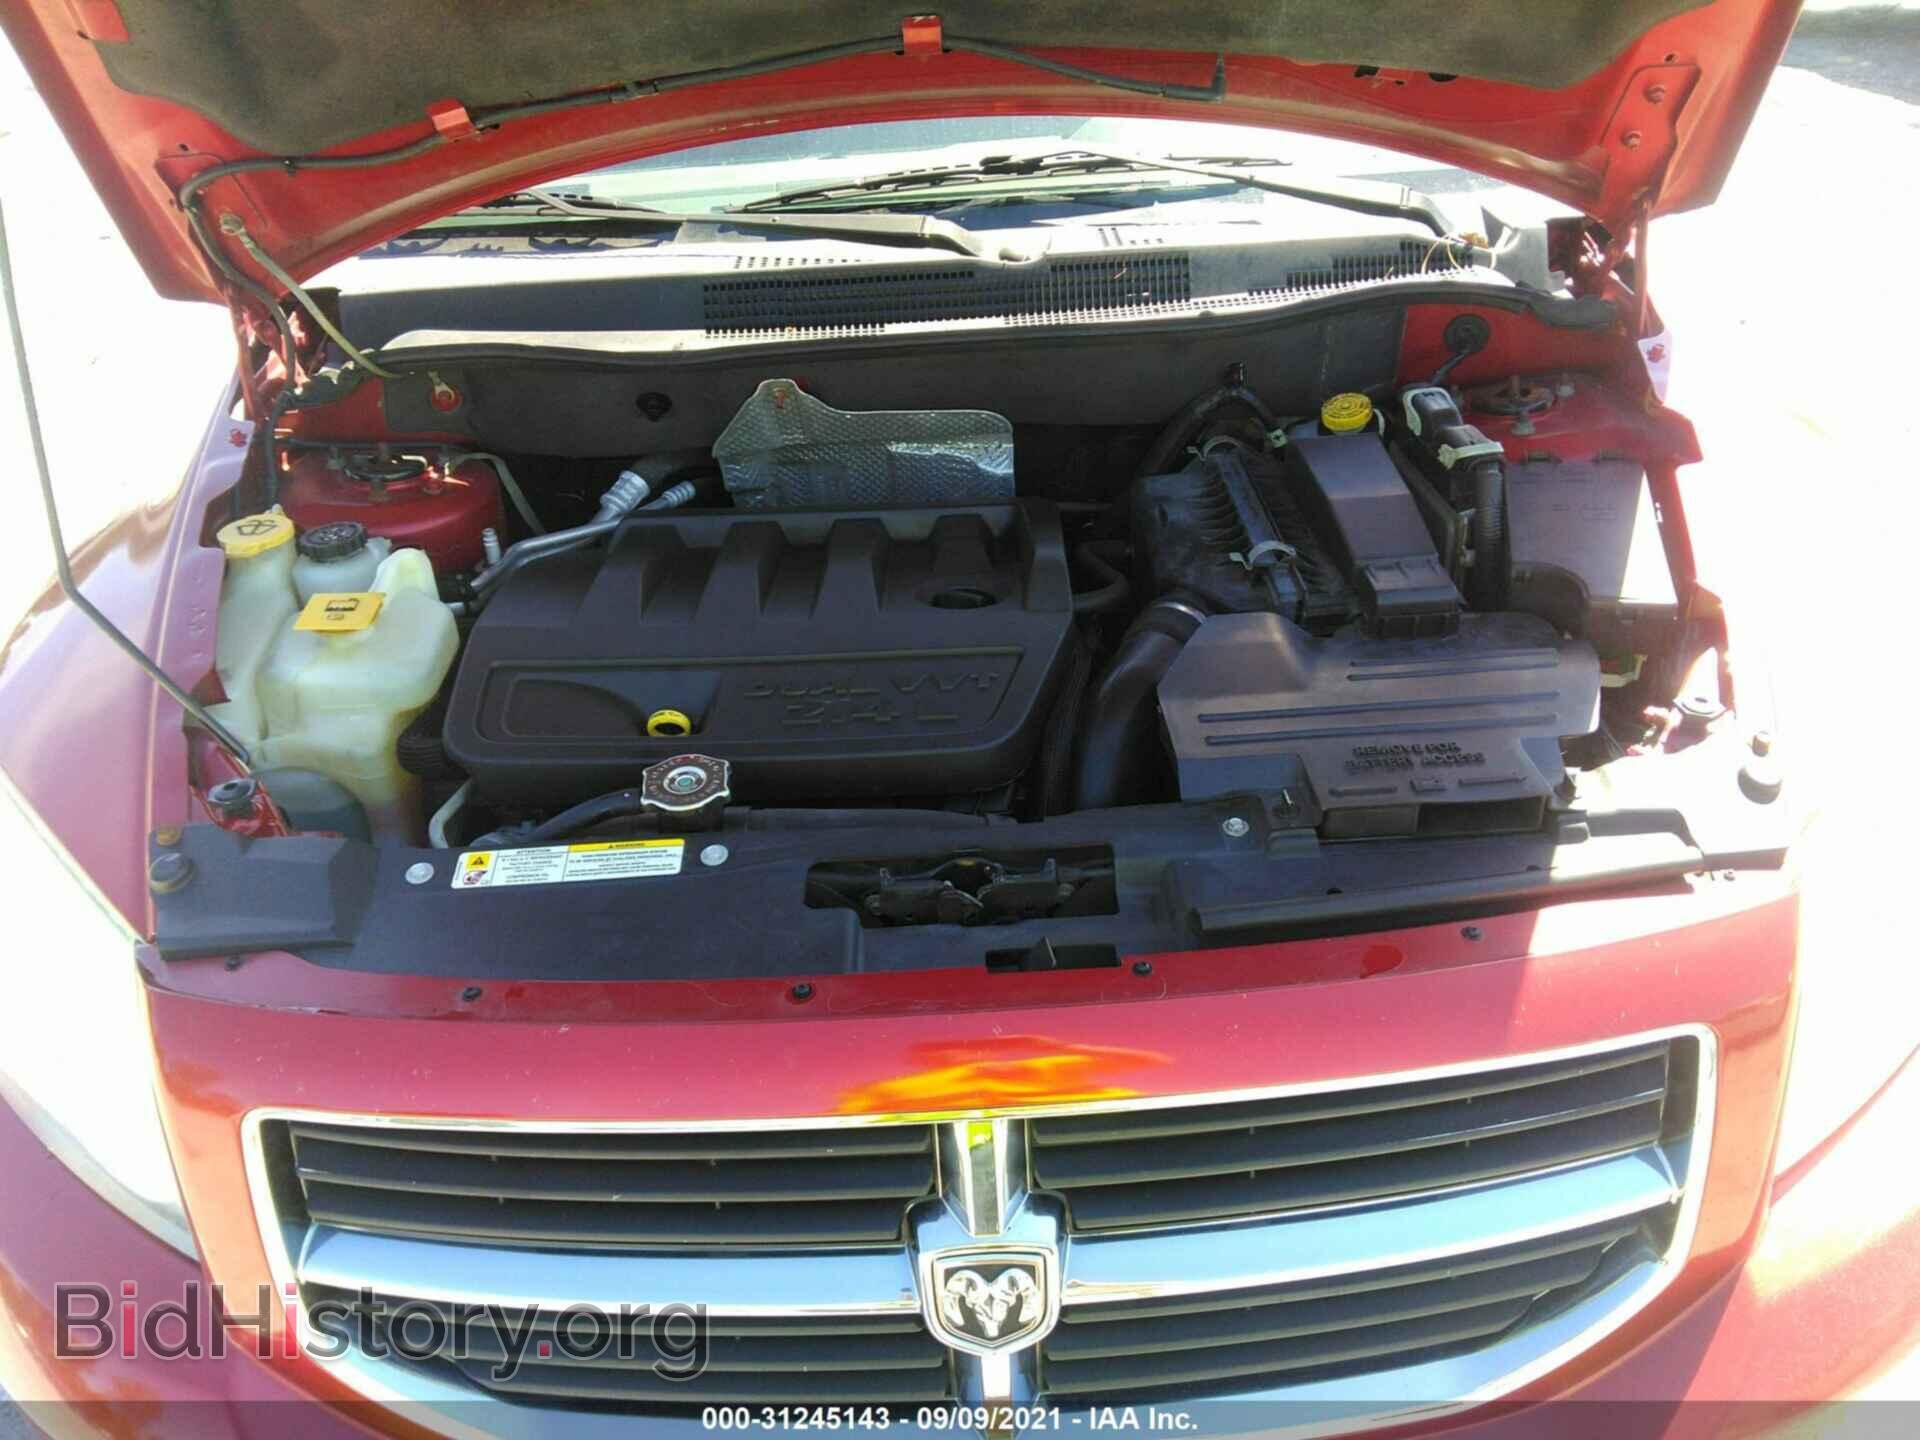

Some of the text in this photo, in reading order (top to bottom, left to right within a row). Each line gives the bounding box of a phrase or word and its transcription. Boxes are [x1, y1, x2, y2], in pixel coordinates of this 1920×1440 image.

[889, 671, 1001, 694] VVT
[1351, 741, 1462, 759] REMOVE FOR
[1344, 752, 1487, 772] BATTERY ACCESS
